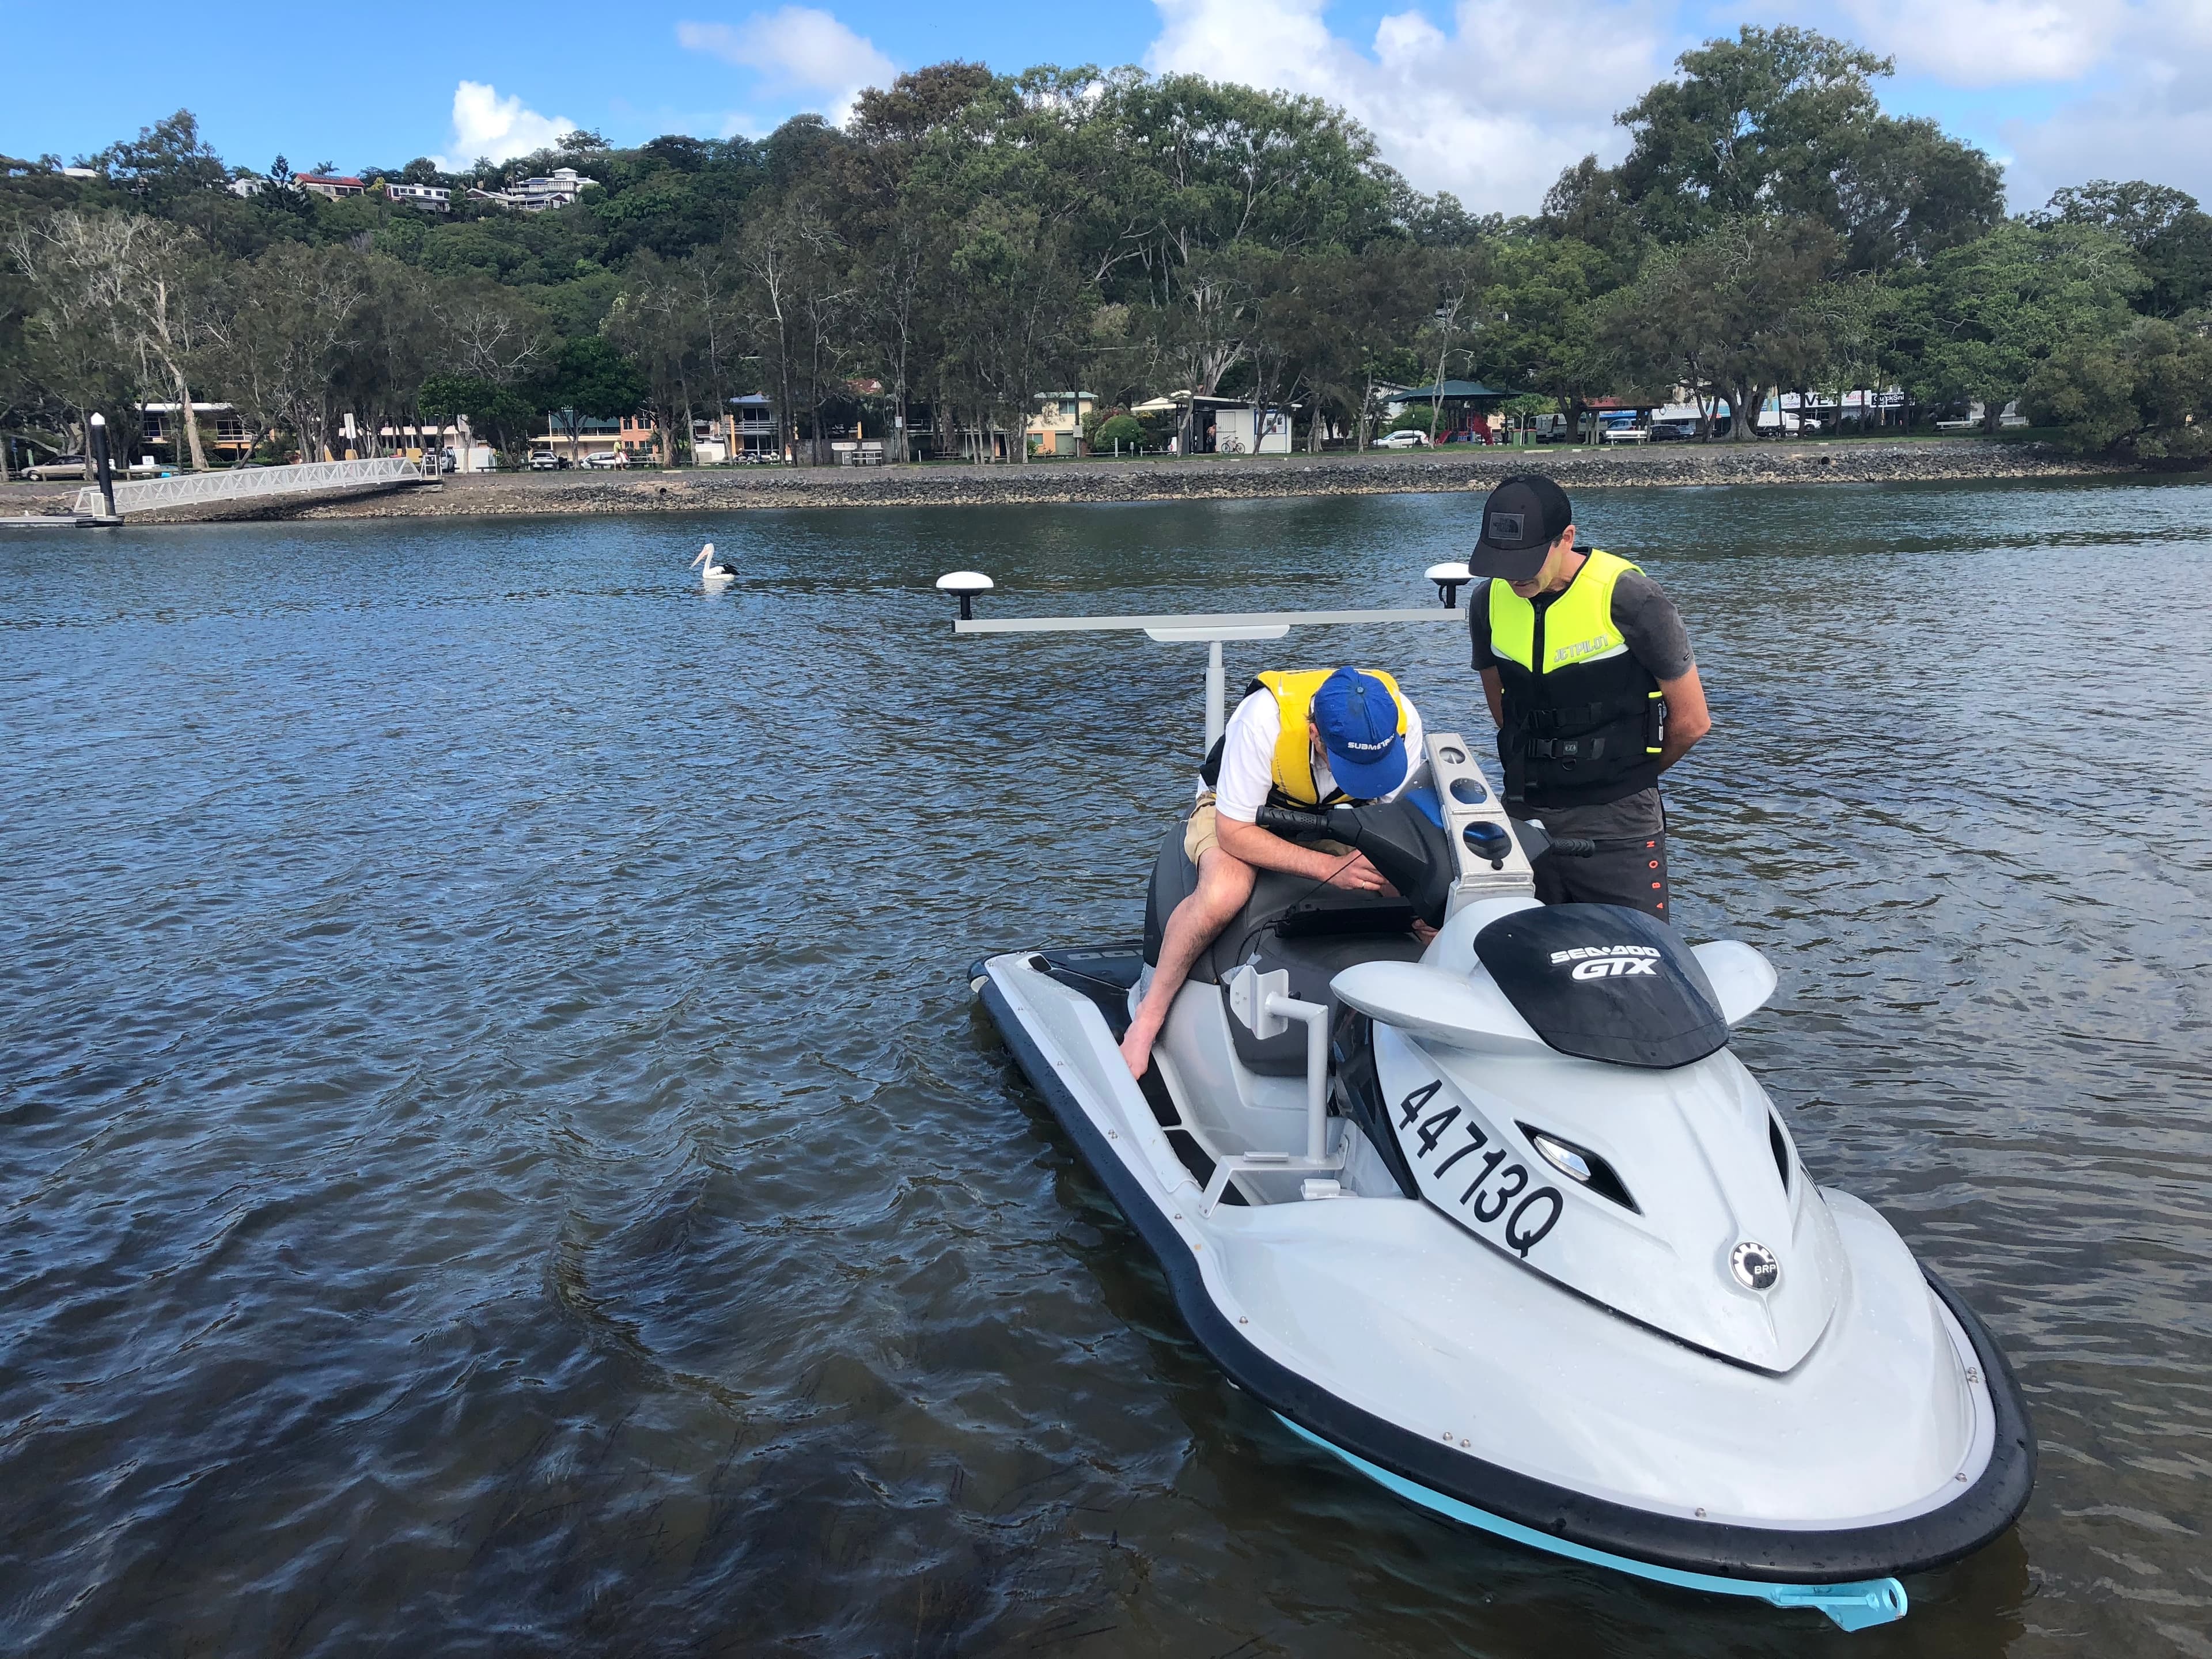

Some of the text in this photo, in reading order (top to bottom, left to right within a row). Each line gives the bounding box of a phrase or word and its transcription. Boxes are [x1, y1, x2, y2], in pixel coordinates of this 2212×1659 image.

[1554, 634, 1608, 662] JETPILOT
[1571, 957, 1657, 980] GTX
[1399, 1078, 1563, 1259] 44713Q
[1754, 1264, 1776, 1275] BRP
